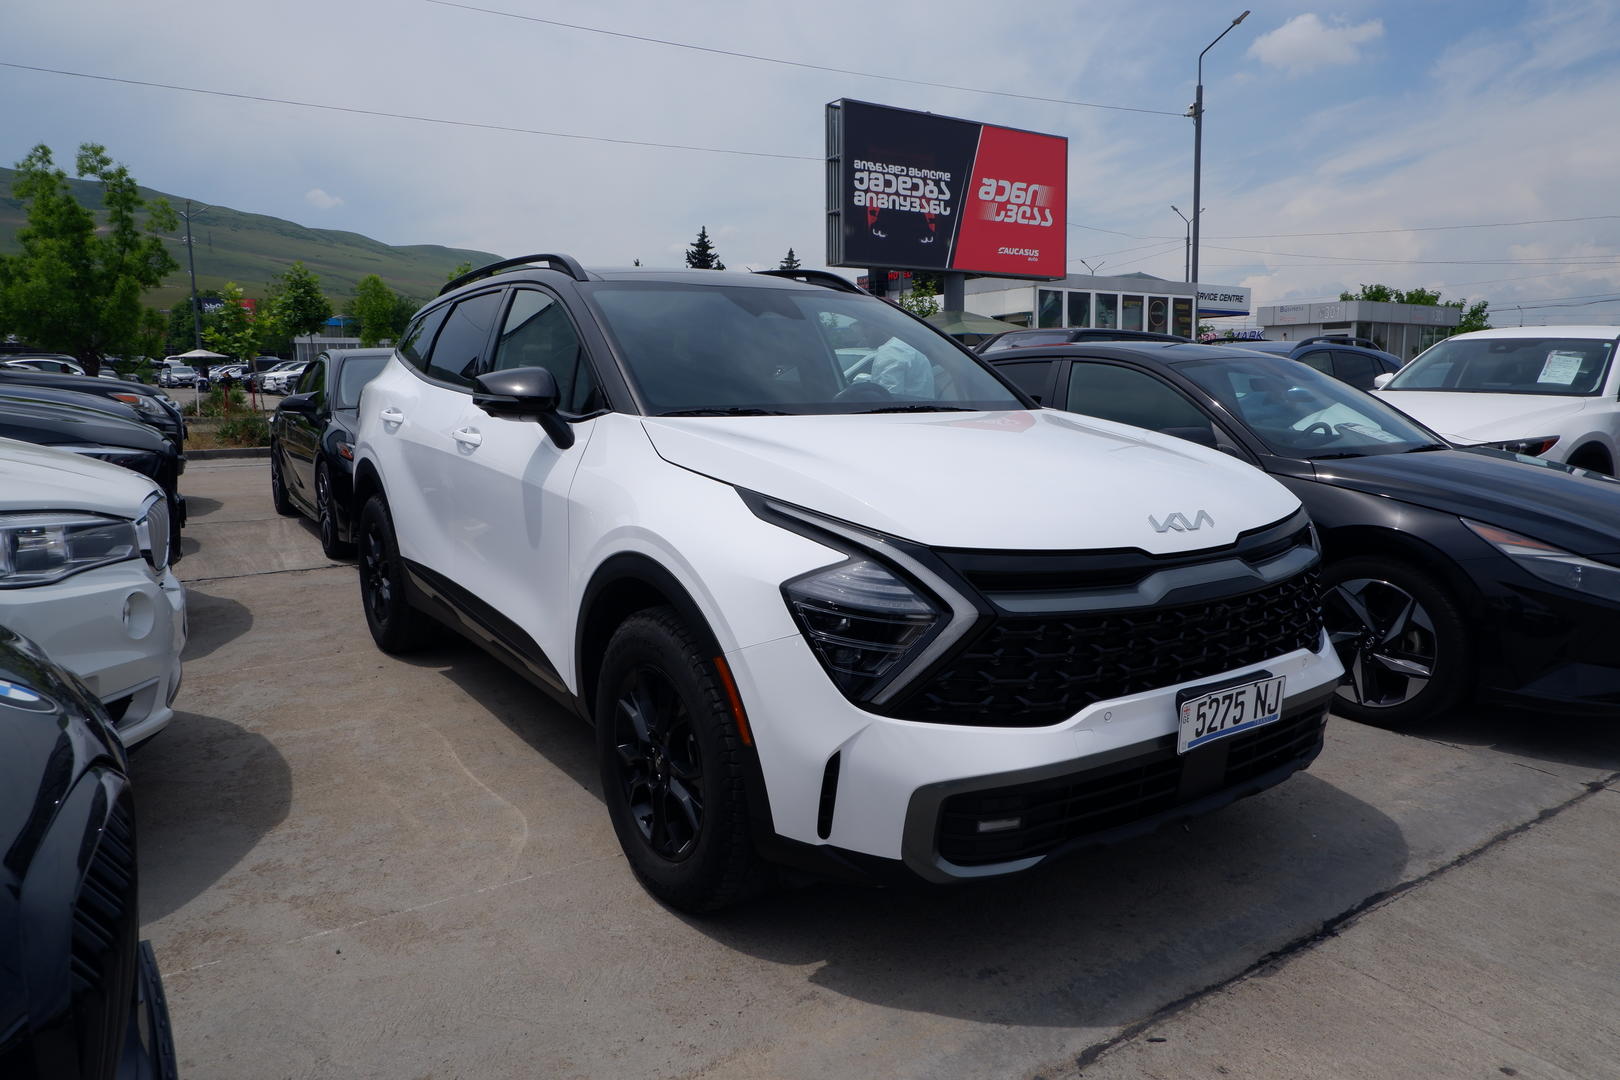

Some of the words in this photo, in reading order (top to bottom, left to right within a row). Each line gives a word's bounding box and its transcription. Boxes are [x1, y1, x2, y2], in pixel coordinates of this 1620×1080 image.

[853, 171, 951, 201] ქმედება
[978, 177, 1041, 206] შენი
[853, 190, 951, 216] მიგიყვანს
[993, 202, 1054, 227] სვლაა
[997, 246, 1039, 257] CAUCASUS
[1197, 291, 1219, 301] ERVICE
[1219, 293, 1244, 303] CENTRE
[1195, 690, 1246, 738] 5275
[1253, 680, 1281, 719] NJ
